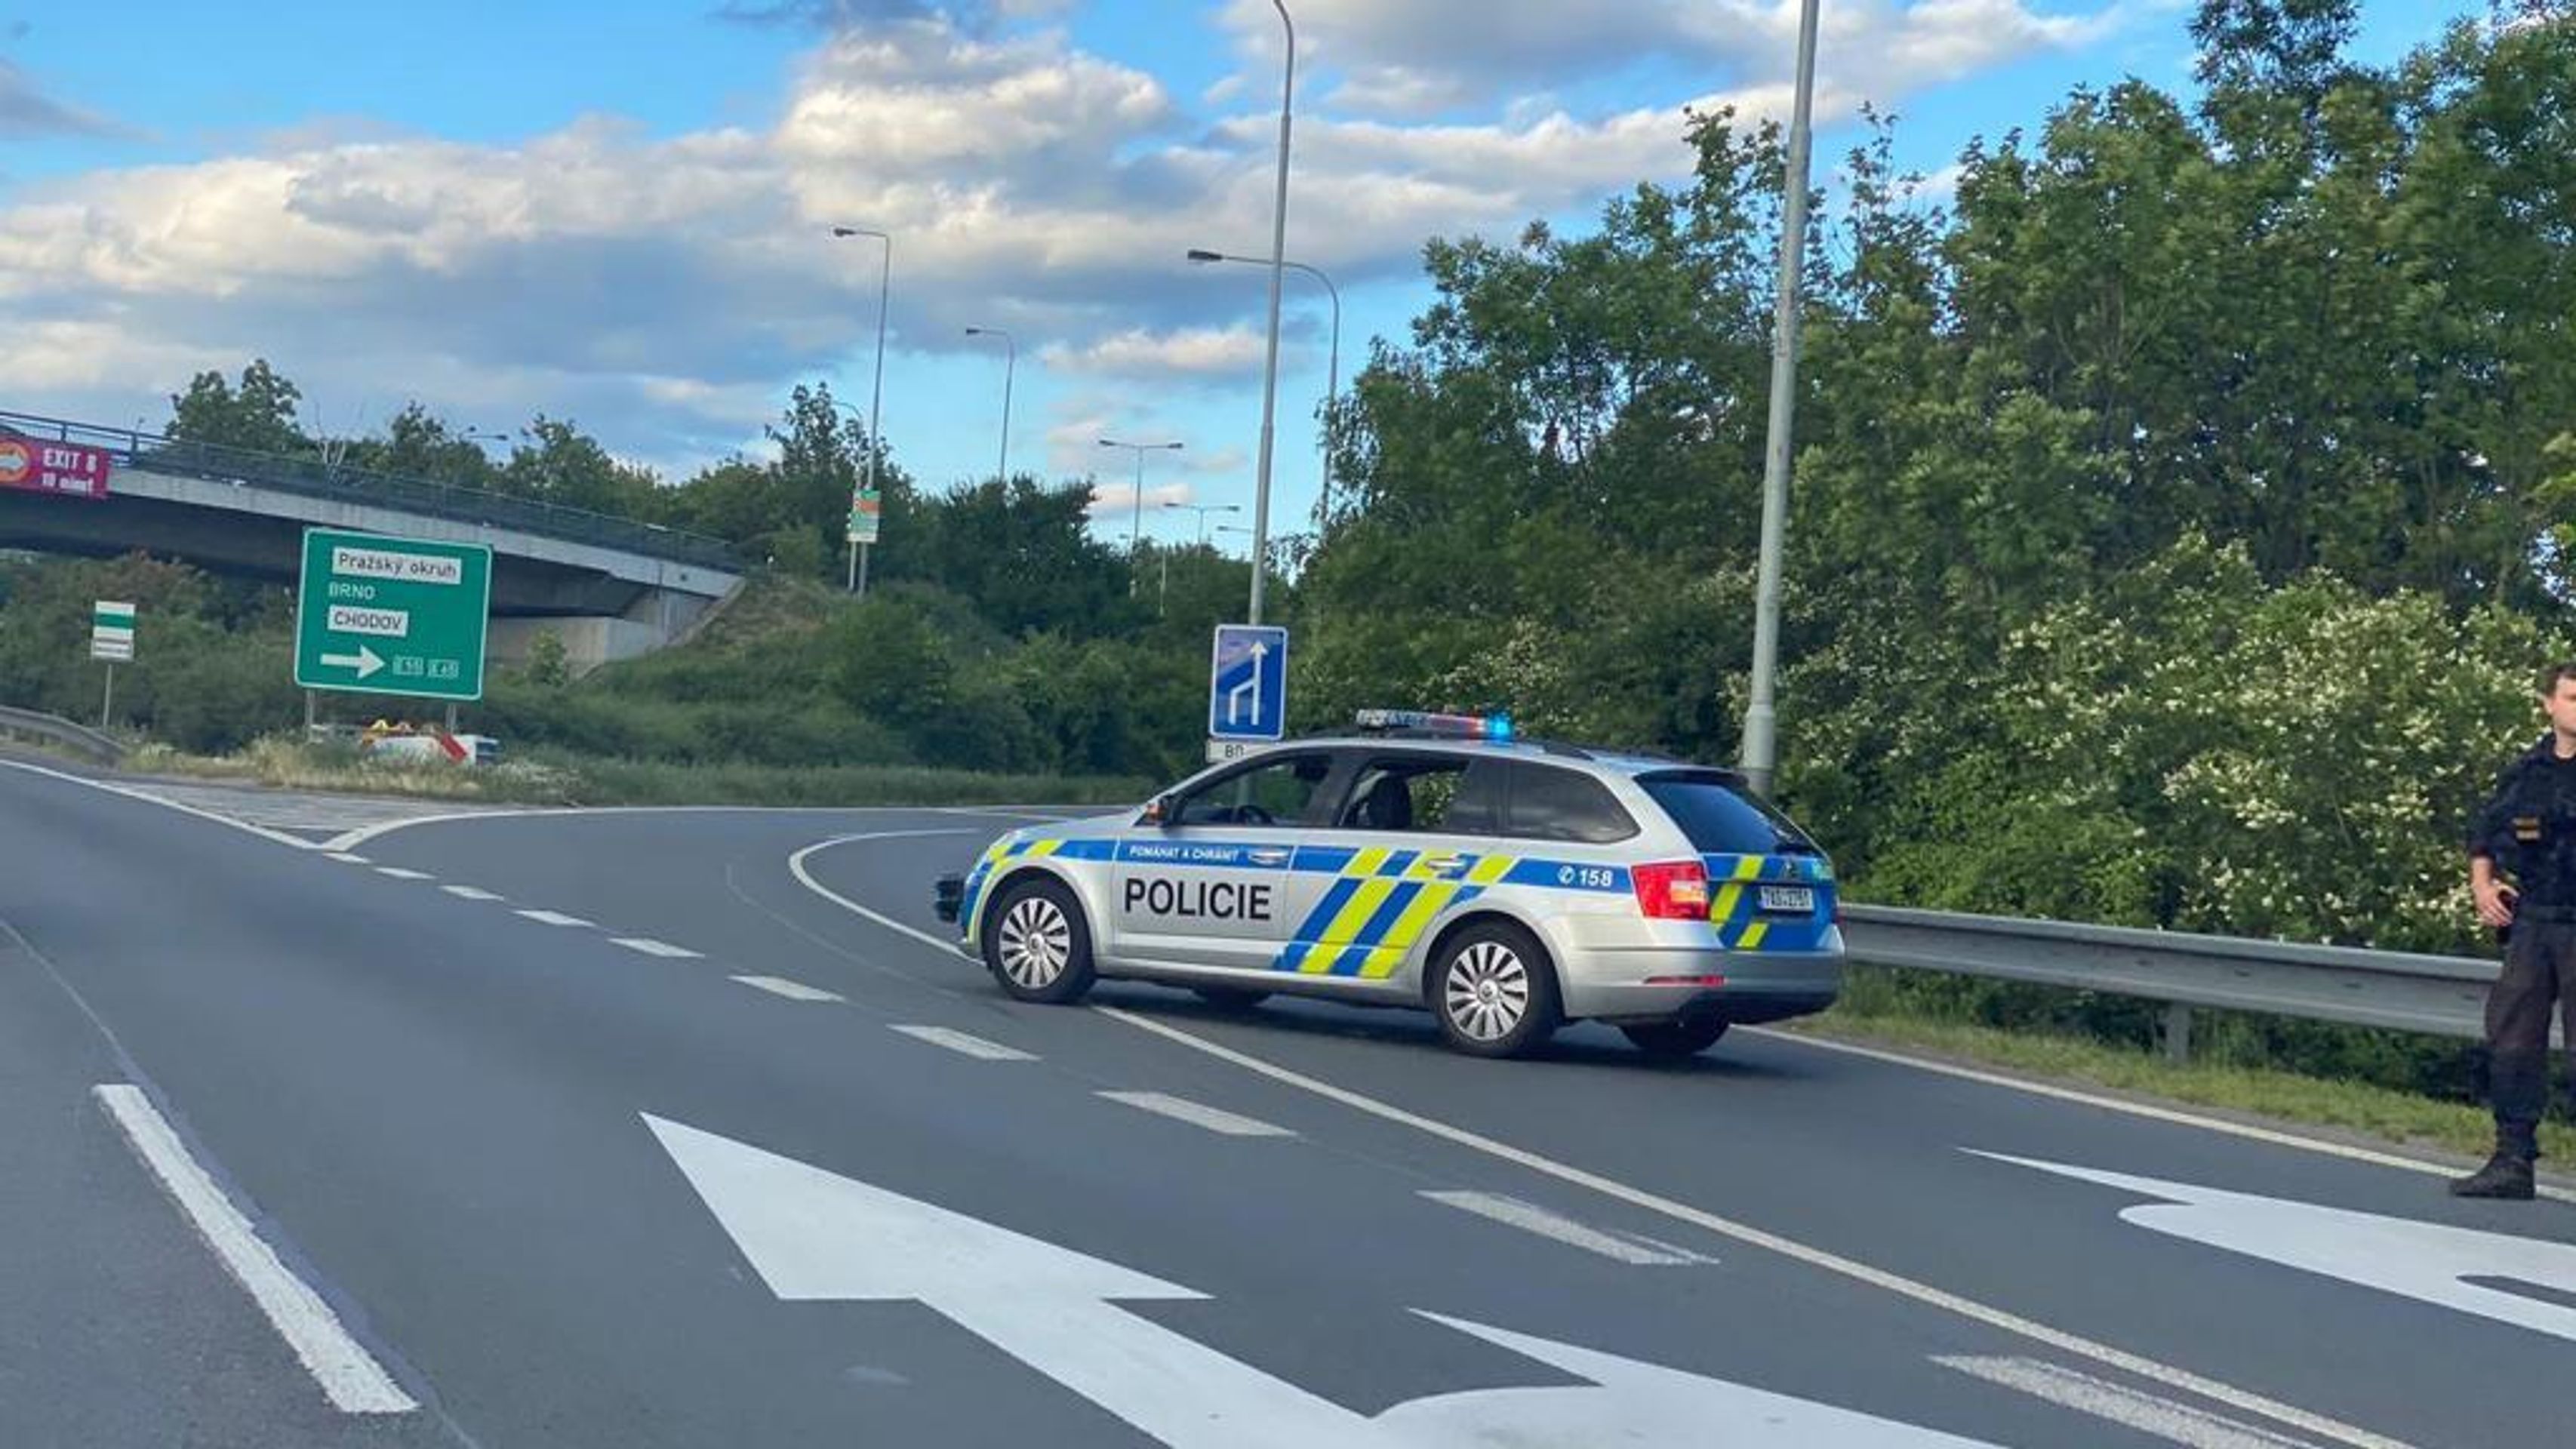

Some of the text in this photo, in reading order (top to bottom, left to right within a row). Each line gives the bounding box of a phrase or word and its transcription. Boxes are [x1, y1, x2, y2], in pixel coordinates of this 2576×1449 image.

[43, 448, 82, 469] EXIT
[339, 552, 457, 577] Pražský okruh
[328, 582, 377, 600] BRNO
[334, 611, 402, 630] CHODOV
[1578, 869, 1614, 888] 158
[1125, 878, 1272, 920] POLICIE
